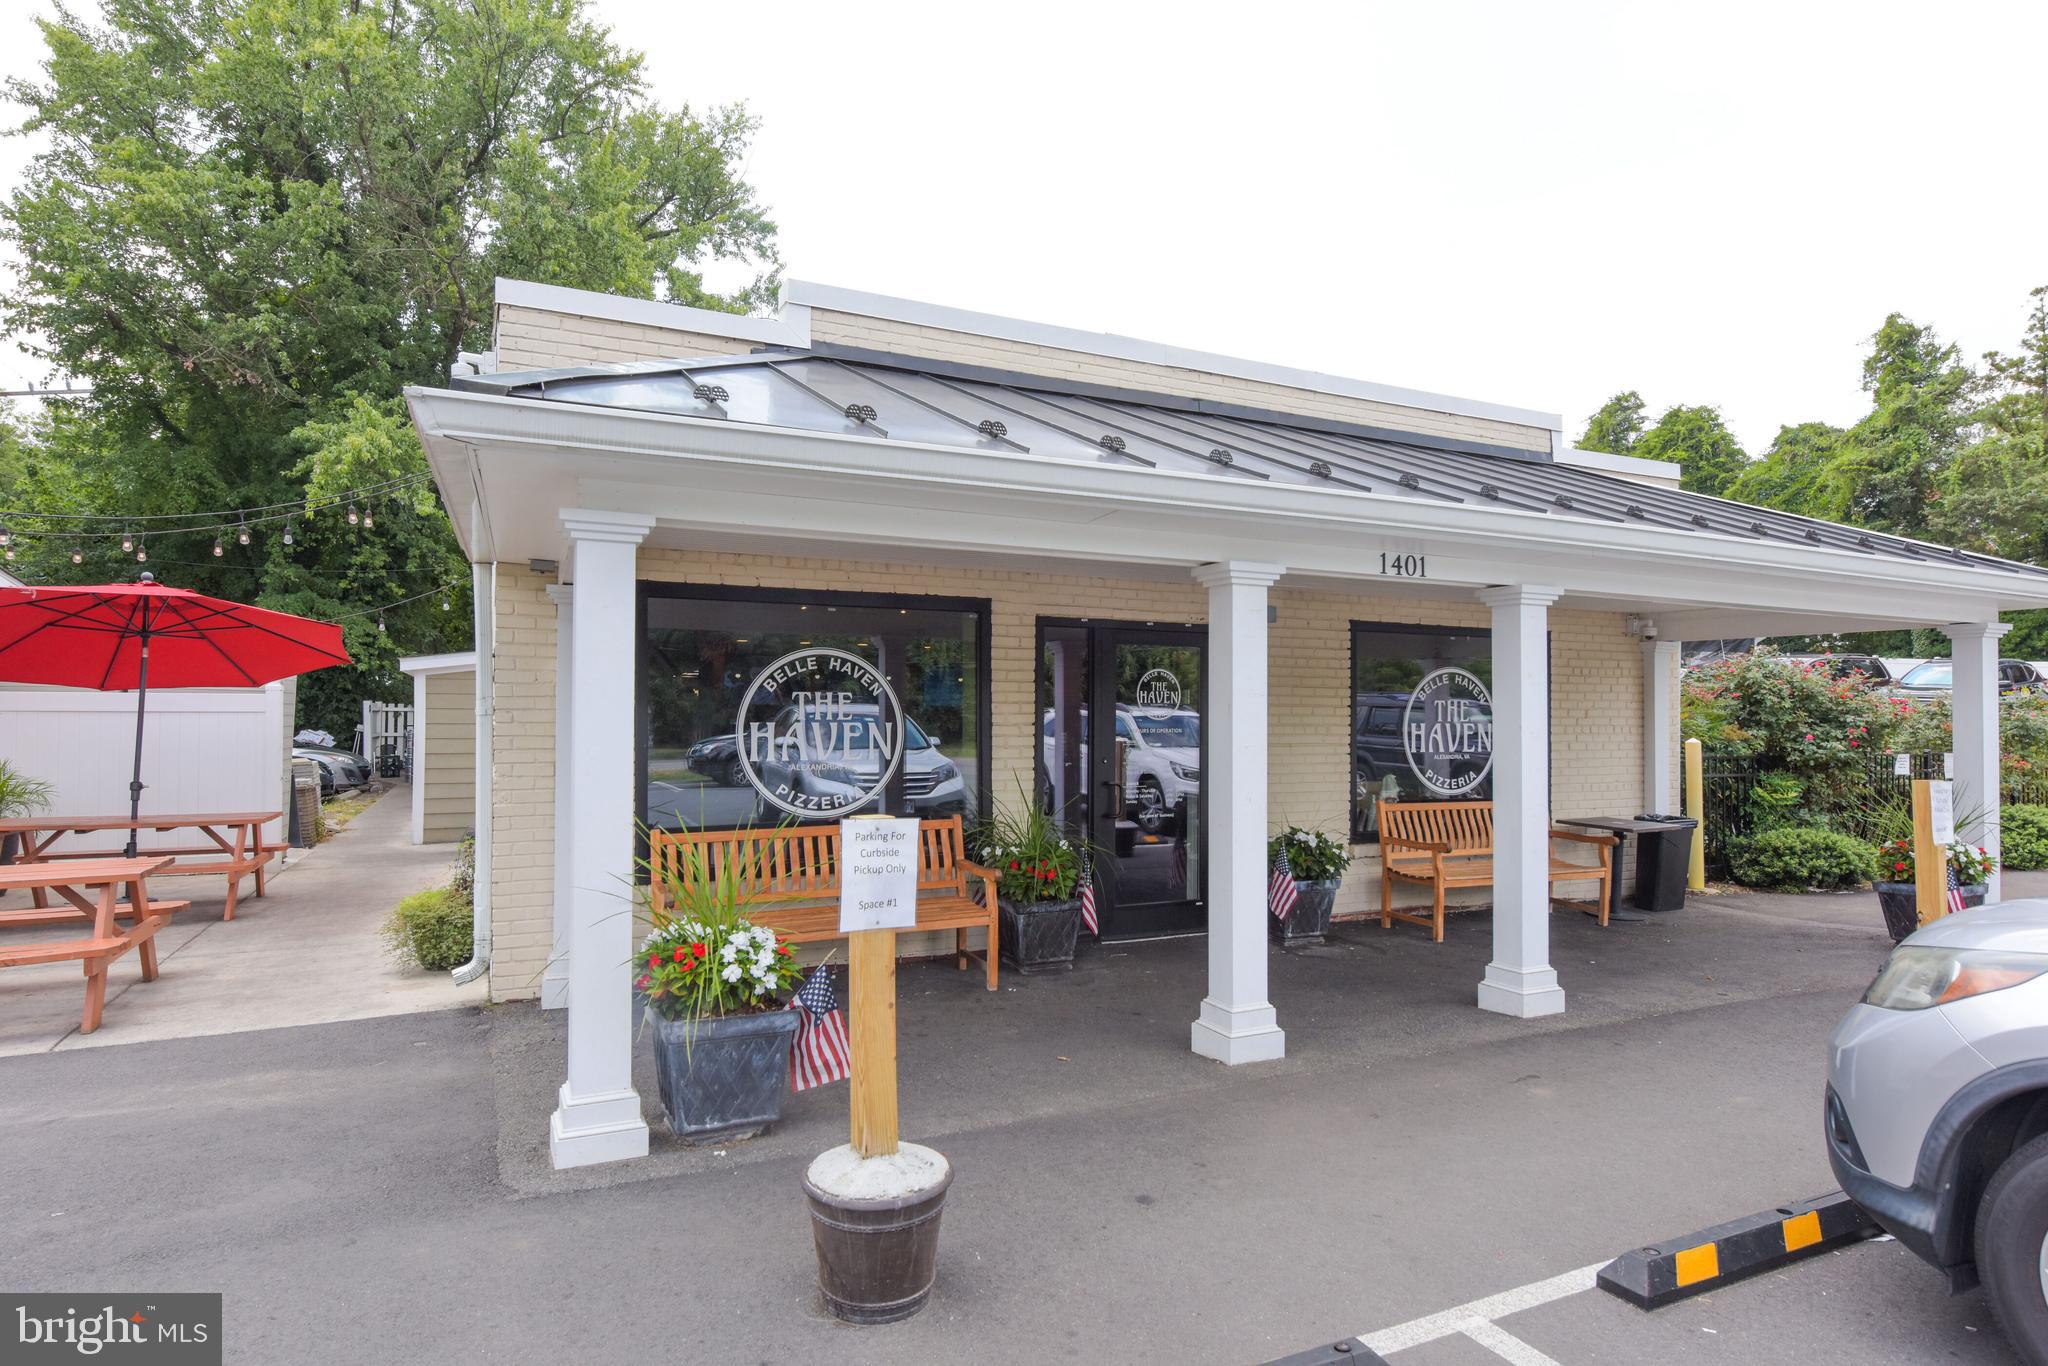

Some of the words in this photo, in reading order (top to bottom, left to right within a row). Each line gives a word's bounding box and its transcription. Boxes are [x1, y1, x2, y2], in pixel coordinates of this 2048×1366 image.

[1380, 552, 1427, 578] 1401
[762, 657, 818, 692] BELLE
[829, 657, 883, 697] HAVEN
[1150, 681, 1168, 691] THE
[1140, 691, 1178, 704] HAVEN
[1418, 674, 1449, 701] BELLE
[1455, 675, 1486, 703] HAVEN
[791, 691, 853, 721] THE
[1434, 700, 1470, 722] THE
[749, 721, 893, 762] HAVEN
[1411, 723, 1492, 753] HAVEN
[1425, 769, 1477, 789] PIZZERIA
[855, 831, 888, 842] Parking
[891, 831, 906, 841] For
[860, 848, 900, 858] Curbside
[854, 865, 884, 875] Pickup
[886, 863, 907, 874] Only
[858, 900, 884, 912] Space
[886, 898, 897, 908] #1
